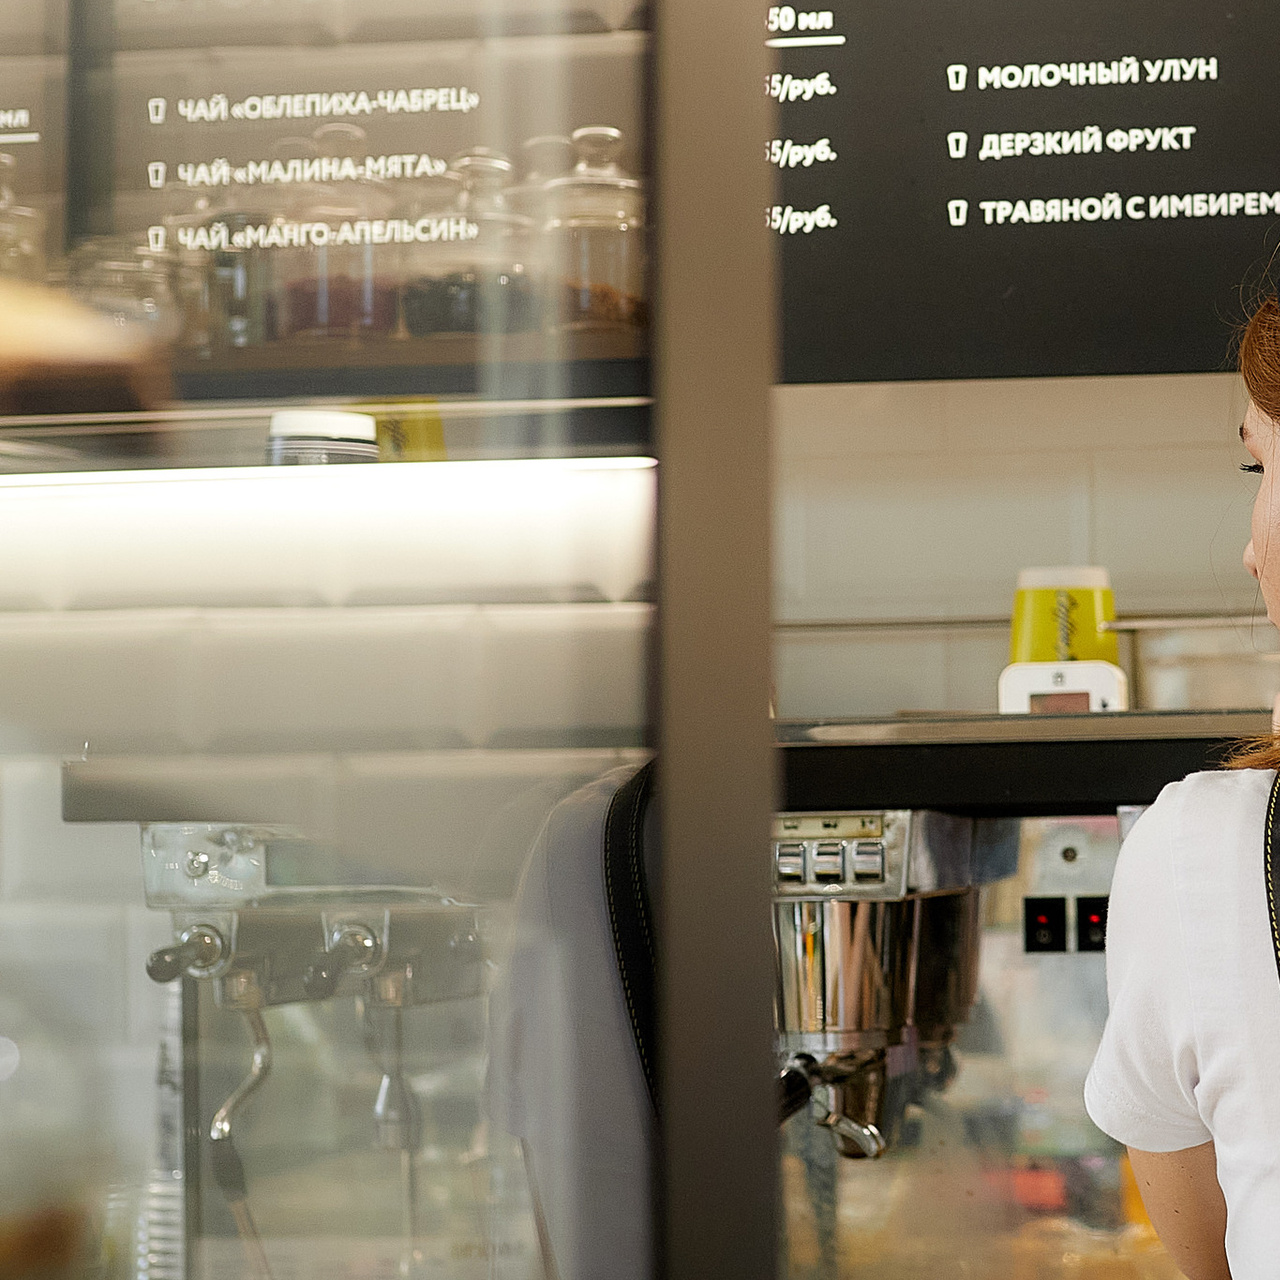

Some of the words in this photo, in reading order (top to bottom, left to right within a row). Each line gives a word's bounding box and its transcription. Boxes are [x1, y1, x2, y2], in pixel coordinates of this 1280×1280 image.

[798, 12, 833, 30] мл
[978, 57, 1139, 89] МОЛОЧНЫЙ
[1143, 57, 1217, 82] УЛУН
[178, 94, 228, 122] ЧАЙ
[979, 126, 1102, 160] ДЕРЗКИЙ
[1106, 127, 1196, 152] ФРУКТ
[178, 158, 230, 186] ЧАЙ
[979, 193, 1122, 224] ТРАВЯНОЙ
[1126, 196, 1145, 219] С
[178, 222, 229, 250] ЧАЙ
